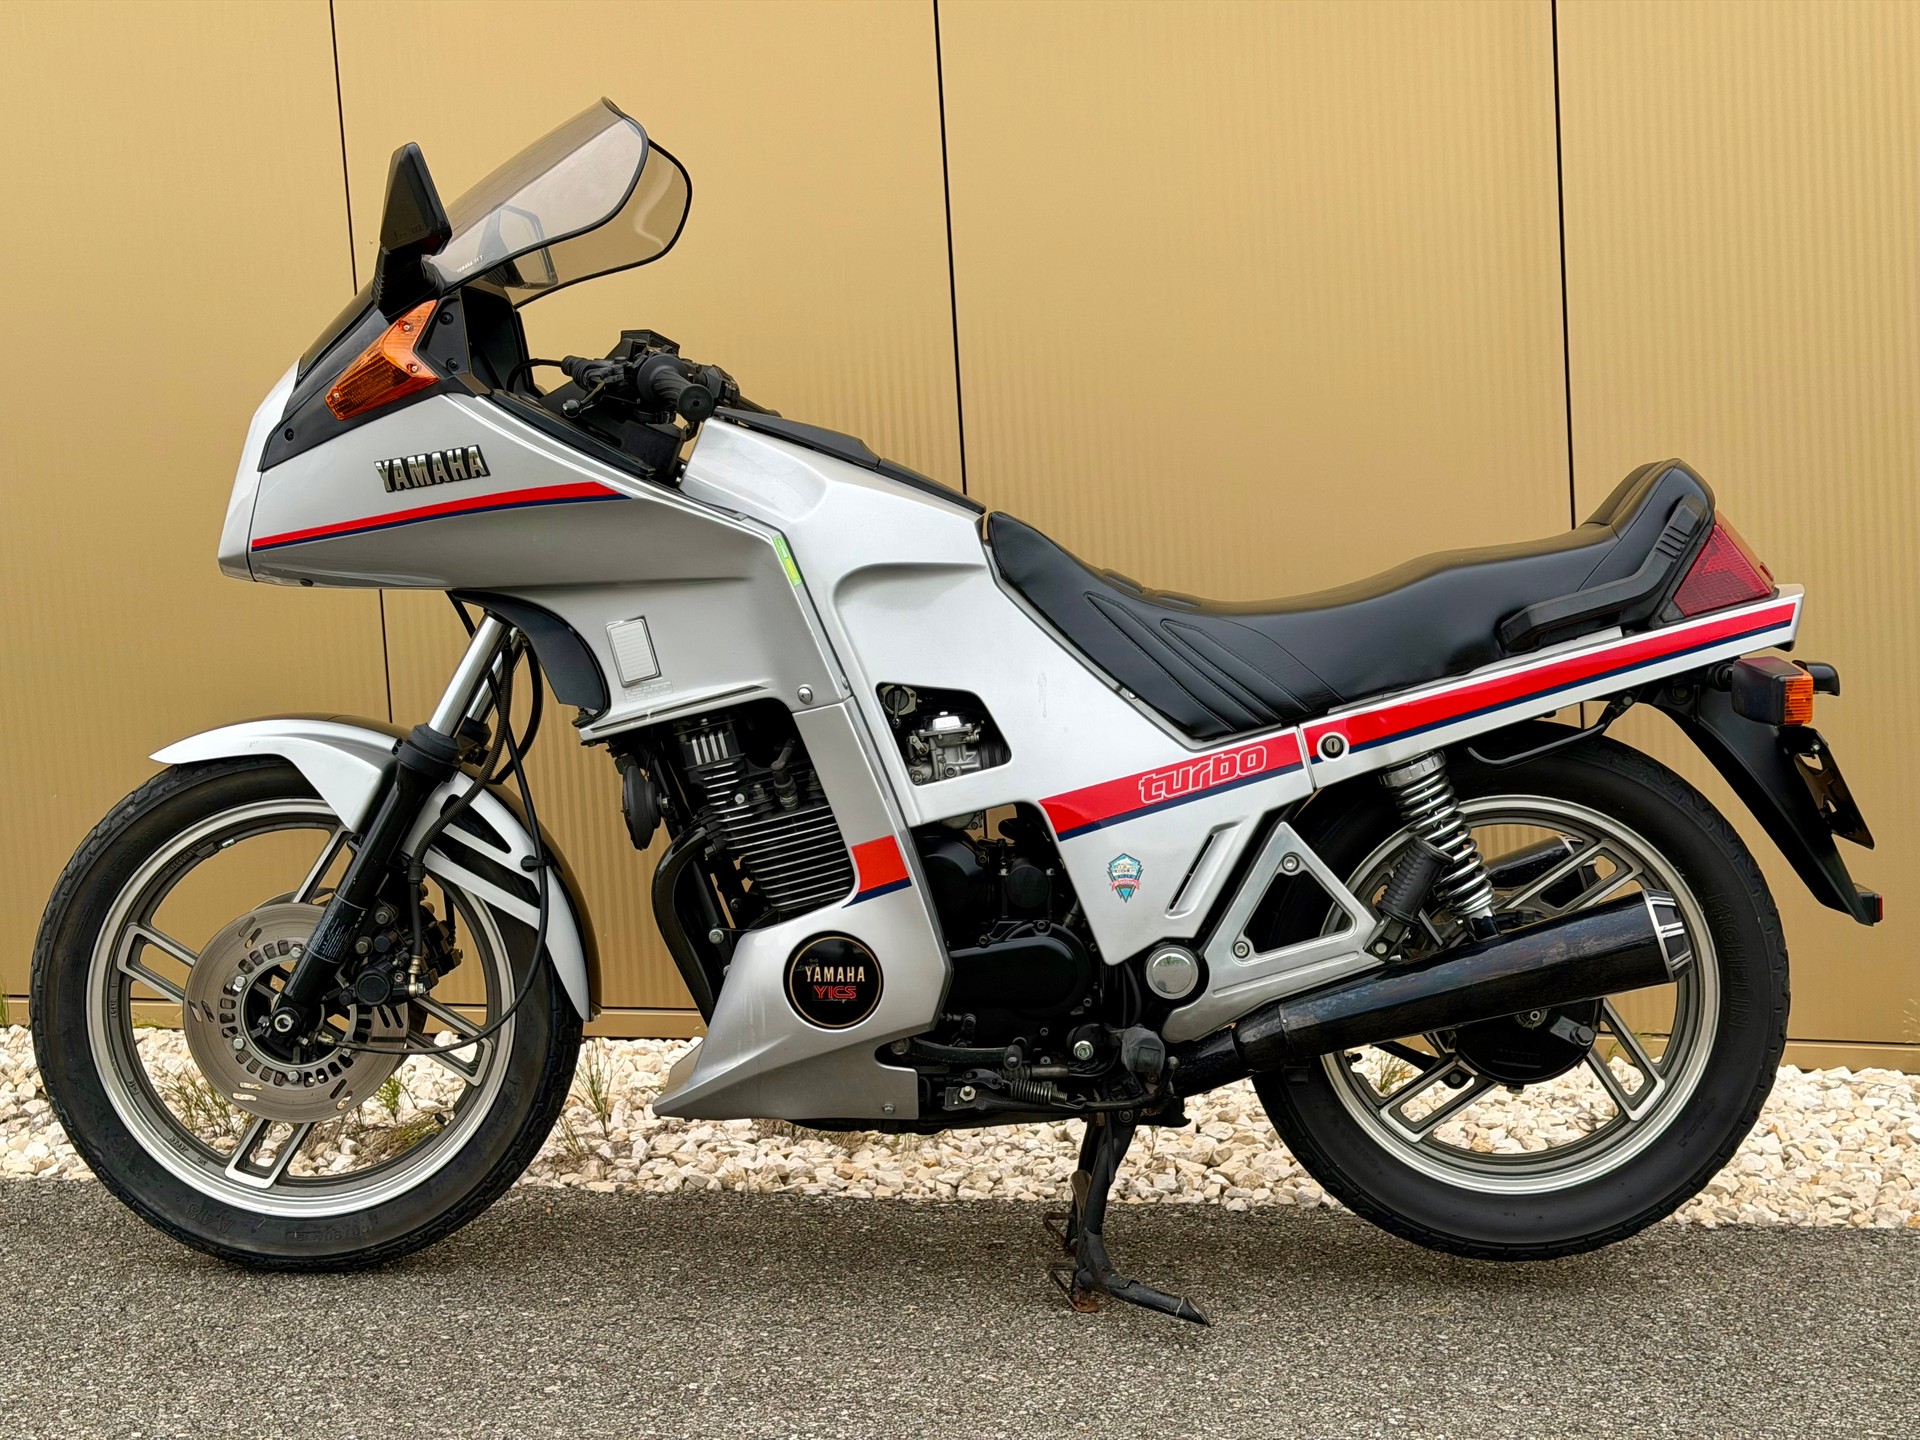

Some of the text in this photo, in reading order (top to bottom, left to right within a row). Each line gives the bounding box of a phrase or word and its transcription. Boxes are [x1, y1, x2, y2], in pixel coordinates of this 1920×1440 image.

[374, 444, 491, 493] YAMAHA
[1138, 745, 1267, 804] turbo
[804, 966, 866, 983] YAMAHA
[1706, 893, 1751, 1029] MICHELIN
[813, 985, 857, 999] YICS
